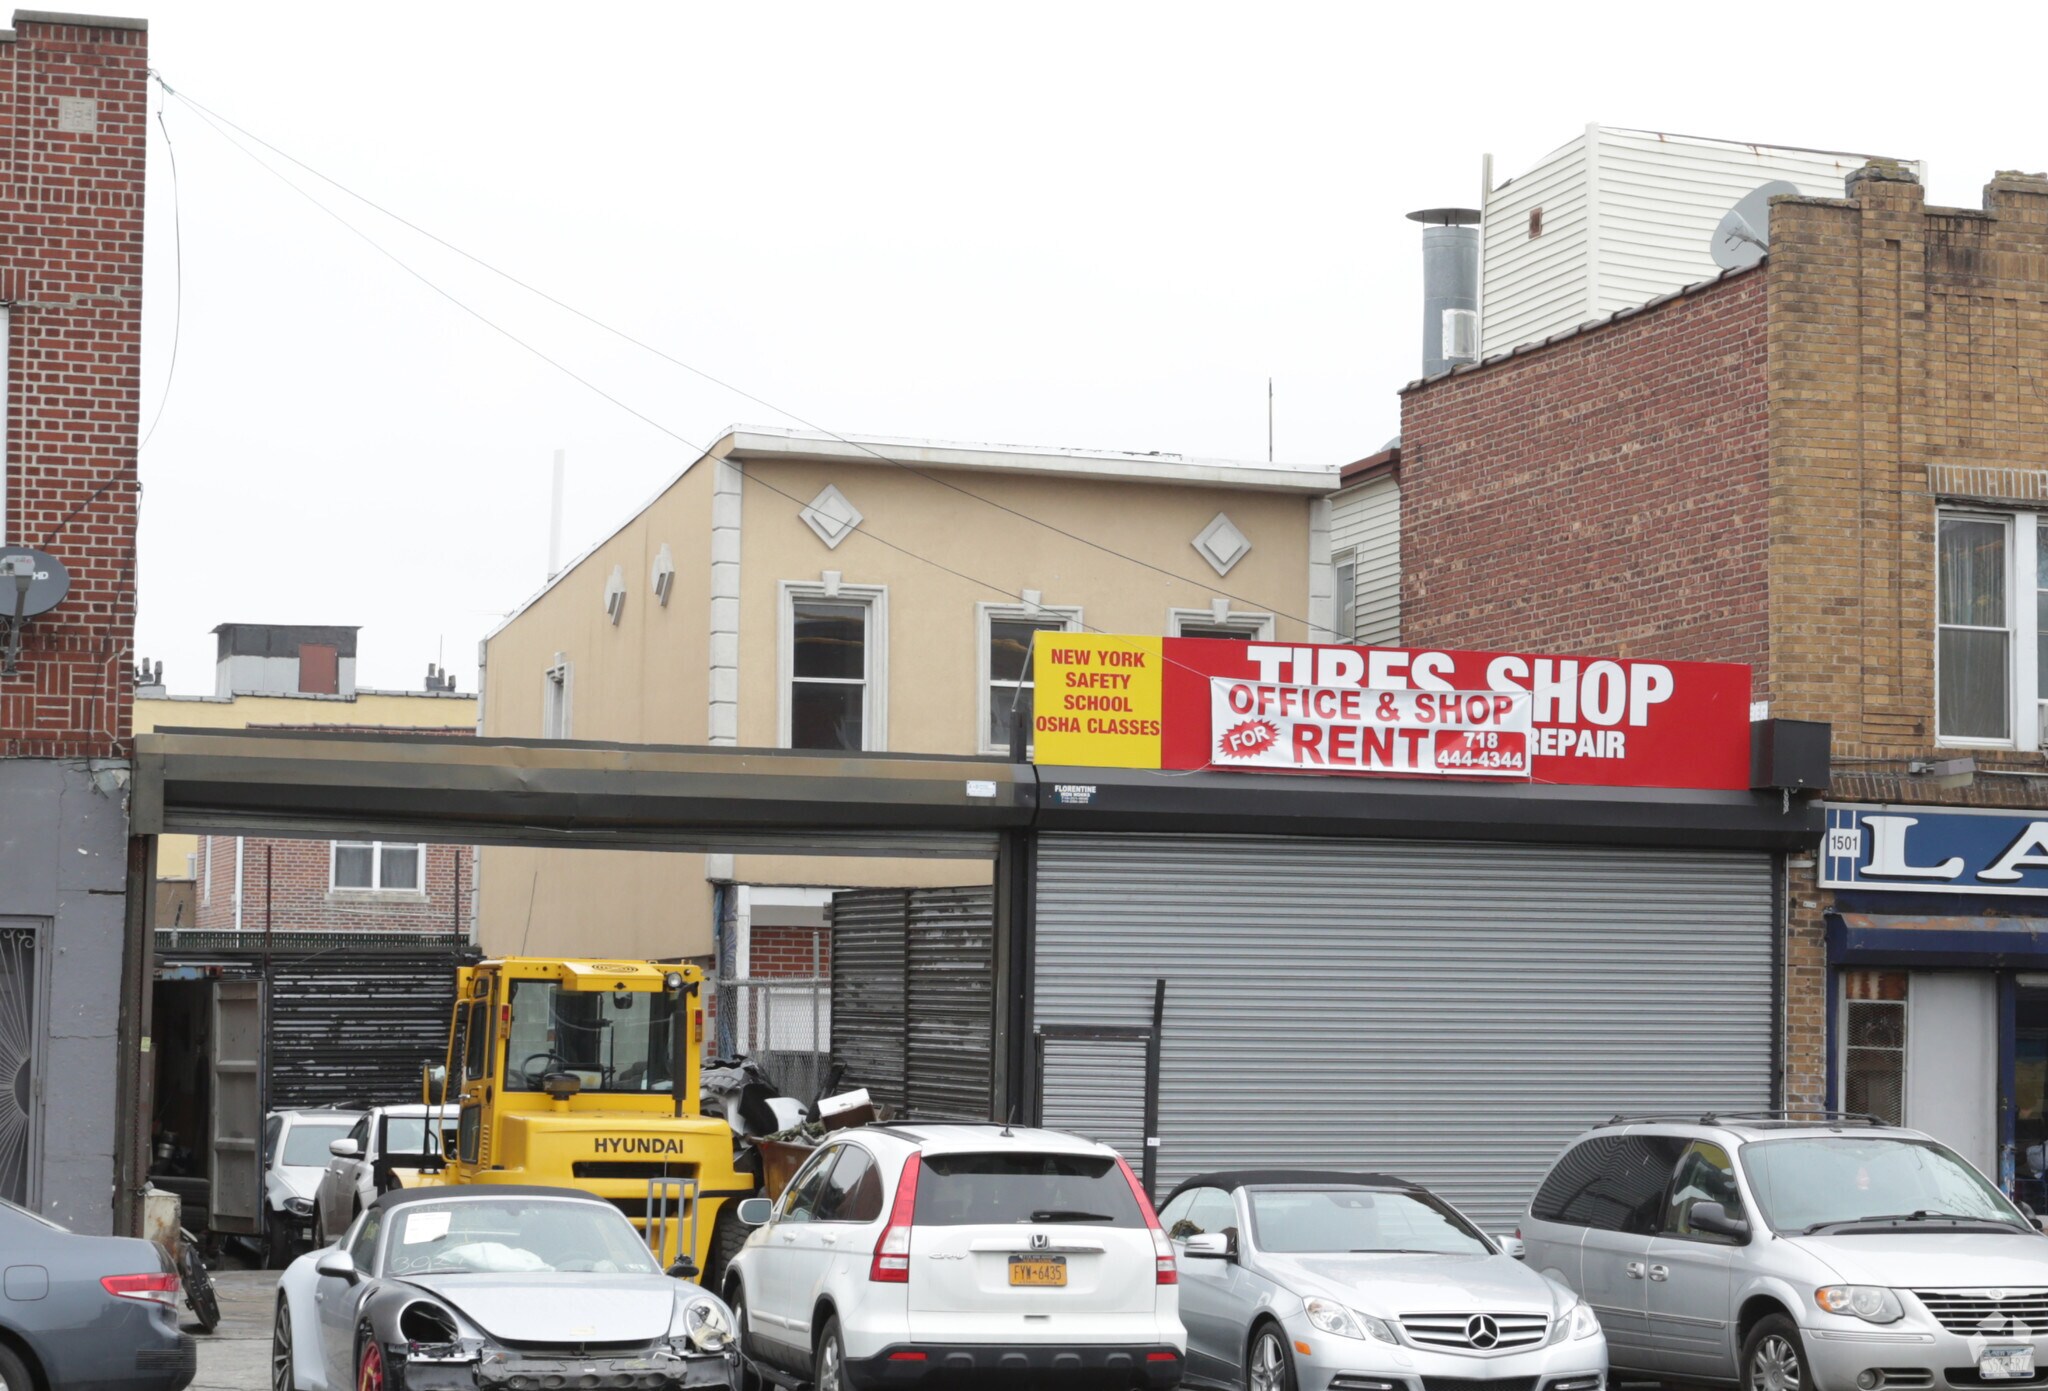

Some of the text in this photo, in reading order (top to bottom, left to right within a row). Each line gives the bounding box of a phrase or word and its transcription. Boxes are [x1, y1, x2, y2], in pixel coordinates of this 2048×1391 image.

[1051, 648, 1146, 668] NEW YORK
[1065, 671, 1131, 690] SAFETY
[1247, 645, 1674, 727] TIRES SHOP
[1063, 694, 1133, 713] SCHOOL
[1228, 684, 1513, 725] OFFICE & SHOP
[1036, 715, 1160, 736] OSHA CLASSES
[1229, 722, 1430, 768] FOR RENT
[1463, 732, 1498, 749] 718
[1437, 750, 1523, 769] 444-4344
[1054, 785, 1097, 793] FLORENTINE
[1831, 835, 1858, 851] 1501
[594, 1137, 684, 1154] HYUNDAI
